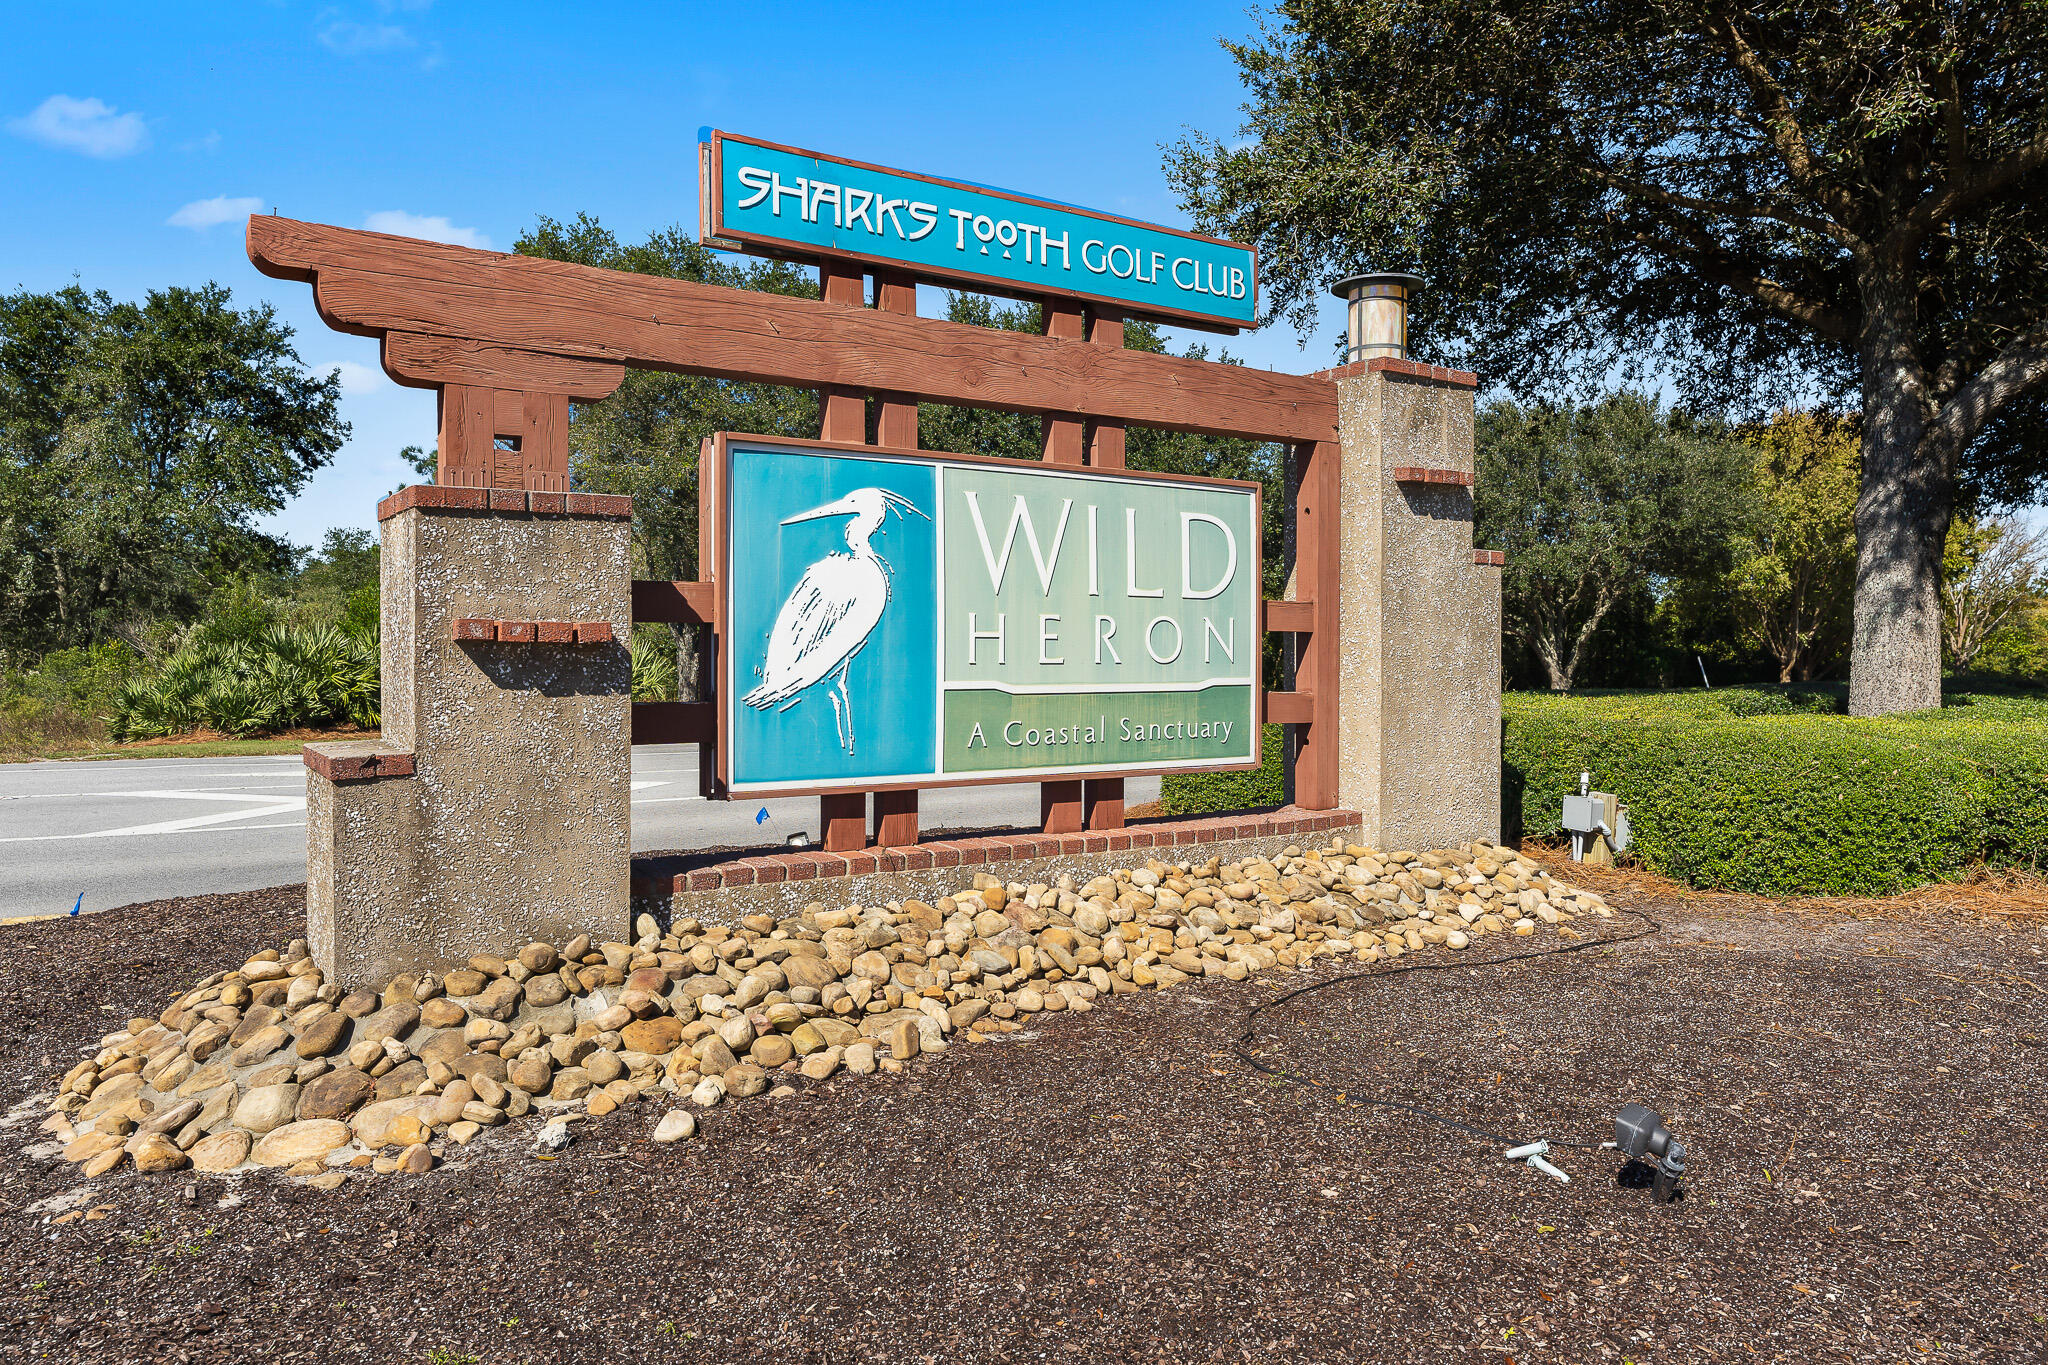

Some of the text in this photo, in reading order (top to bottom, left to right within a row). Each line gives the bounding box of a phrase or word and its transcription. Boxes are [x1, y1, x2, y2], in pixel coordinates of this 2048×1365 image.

[738, 166, 1247, 300] SHARK'S TOOTH GOLF CLUB
[963, 491, 1238, 600] WILD
[968, 612, 1235, 665] HERON
[967, 715, 1234, 748] A Coastal Sanctuary
